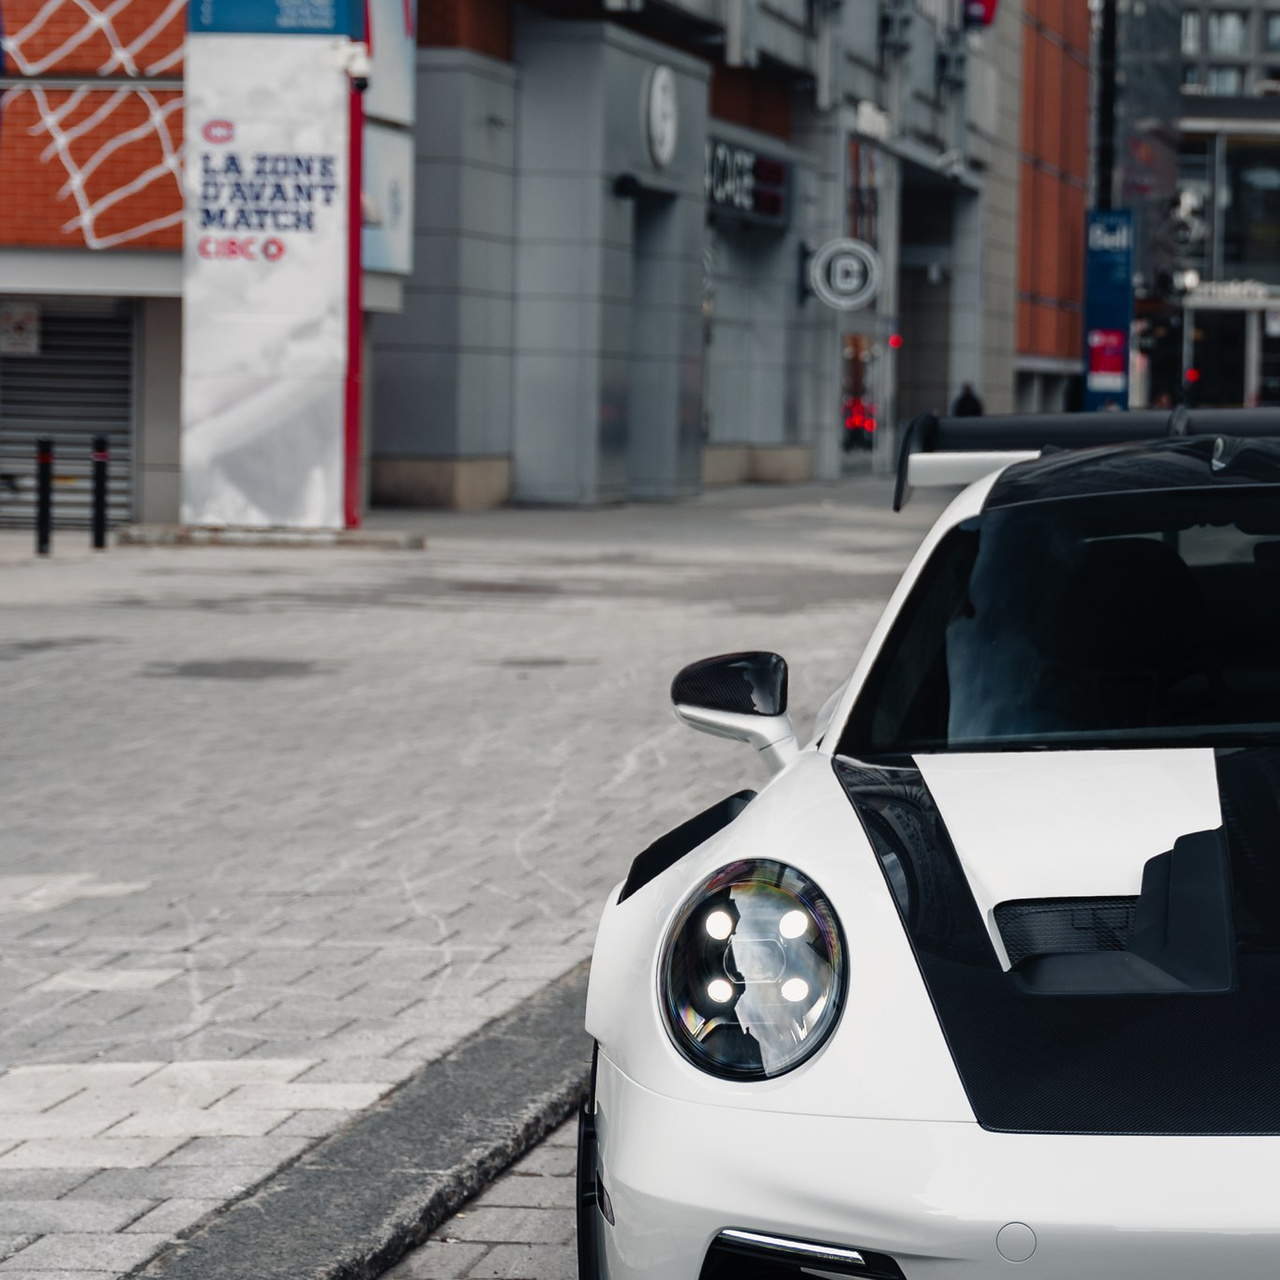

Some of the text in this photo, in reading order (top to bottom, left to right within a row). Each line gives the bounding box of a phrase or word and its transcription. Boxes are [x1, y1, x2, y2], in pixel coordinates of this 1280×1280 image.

[202, 153, 335, 177] LA ZONE
[202, 182, 337, 205] D'AVANT
[201, 208, 314, 232] MATCH
